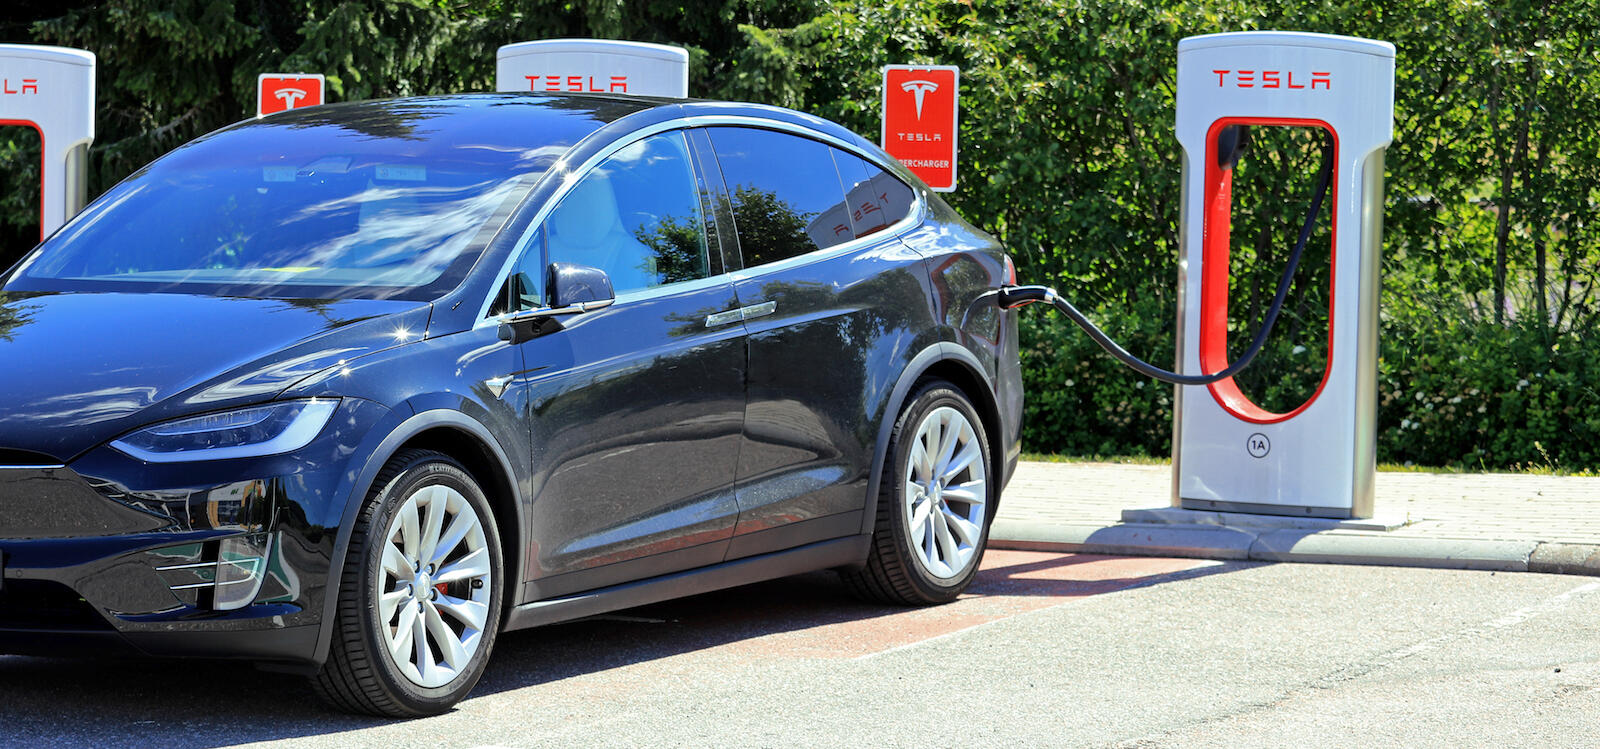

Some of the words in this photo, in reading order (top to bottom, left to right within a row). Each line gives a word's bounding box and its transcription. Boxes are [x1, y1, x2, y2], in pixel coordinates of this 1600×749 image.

[524, 75, 627, 93] TESLA
[1212, 69, 1331, 90] TESLA
[897, 133, 942, 142] TESLA
[898, 159, 949, 168] ERCHARGER
[1251, 440, 1266, 451] 1A
